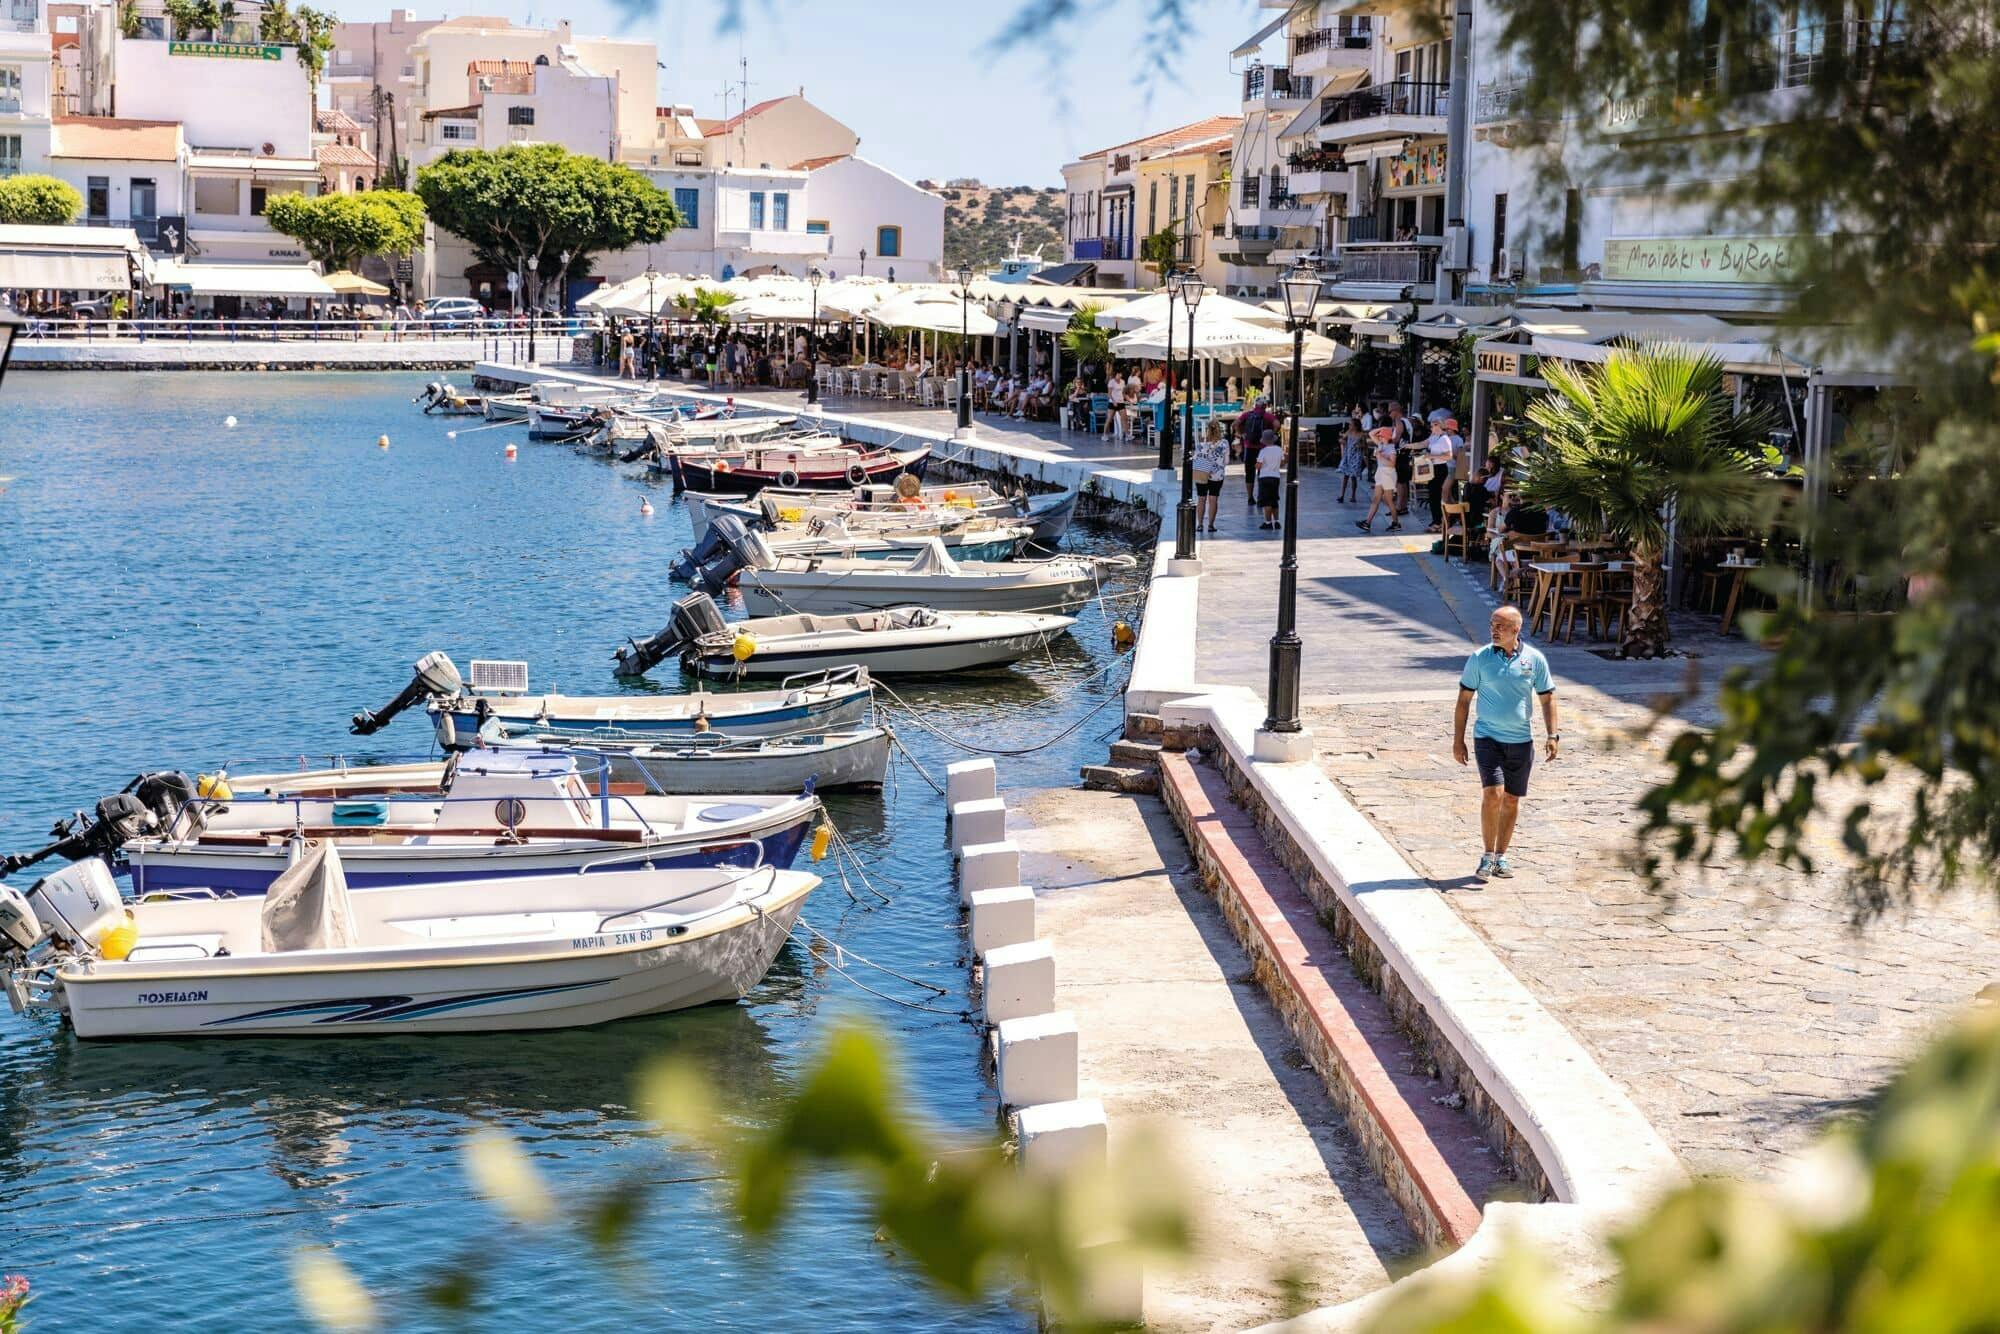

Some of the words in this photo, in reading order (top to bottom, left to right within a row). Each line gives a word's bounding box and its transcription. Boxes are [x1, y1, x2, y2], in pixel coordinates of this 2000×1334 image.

[173, 43, 264, 55] ALEXANDROS
[1478, 353, 1504, 371] SKALA
[640, 930, 653, 941] 63
